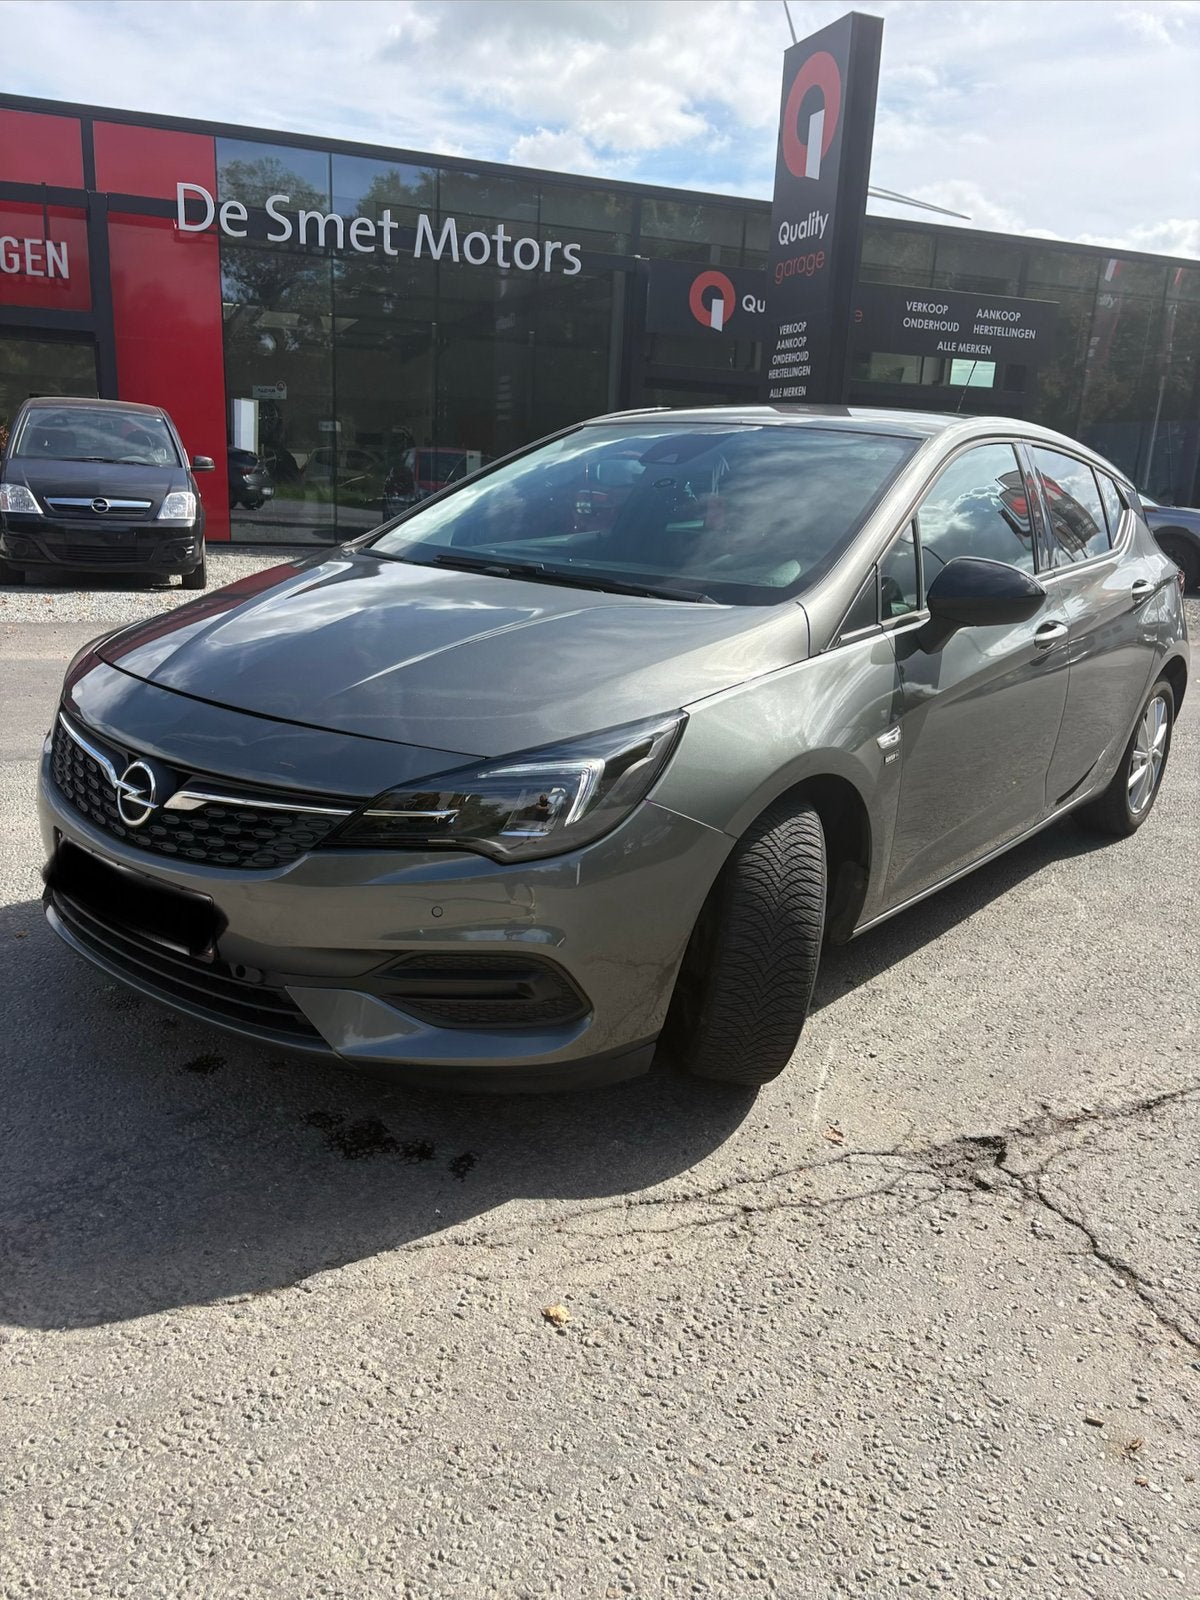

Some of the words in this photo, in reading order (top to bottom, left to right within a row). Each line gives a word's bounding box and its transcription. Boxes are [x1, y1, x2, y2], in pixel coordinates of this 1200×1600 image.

[176, 182, 249, 238] De
[265, 194, 400, 256] Smet
[413, 213, 583, 276] Motors
[778, 210, 829, 245] Quality
[0, 235, 70, 279] GEN
[774, 250, 825, 285] garage
[906, 300, 949, 315] VERKOOP
[976, 308, 1021, 322] AANKOOP
[779, 321, 807, 336] VERKOOP
[903, 317, 960, 333] ONDERHOUD
[973, 324, 1036, 340] HERSTELLINGEN
[776, 336, 807, 350] AANKOOP
[936, 341, 957, 352] ALLE
[958, 343, 992, 355] MERKEN
[772, 350, 810, 365] ONDERHOUD
[768, 365, 812, 380] HERSTELLINGEN
[769, 388, 782, 399] ALLE
[783, 385, 807, 397] MERKEN
